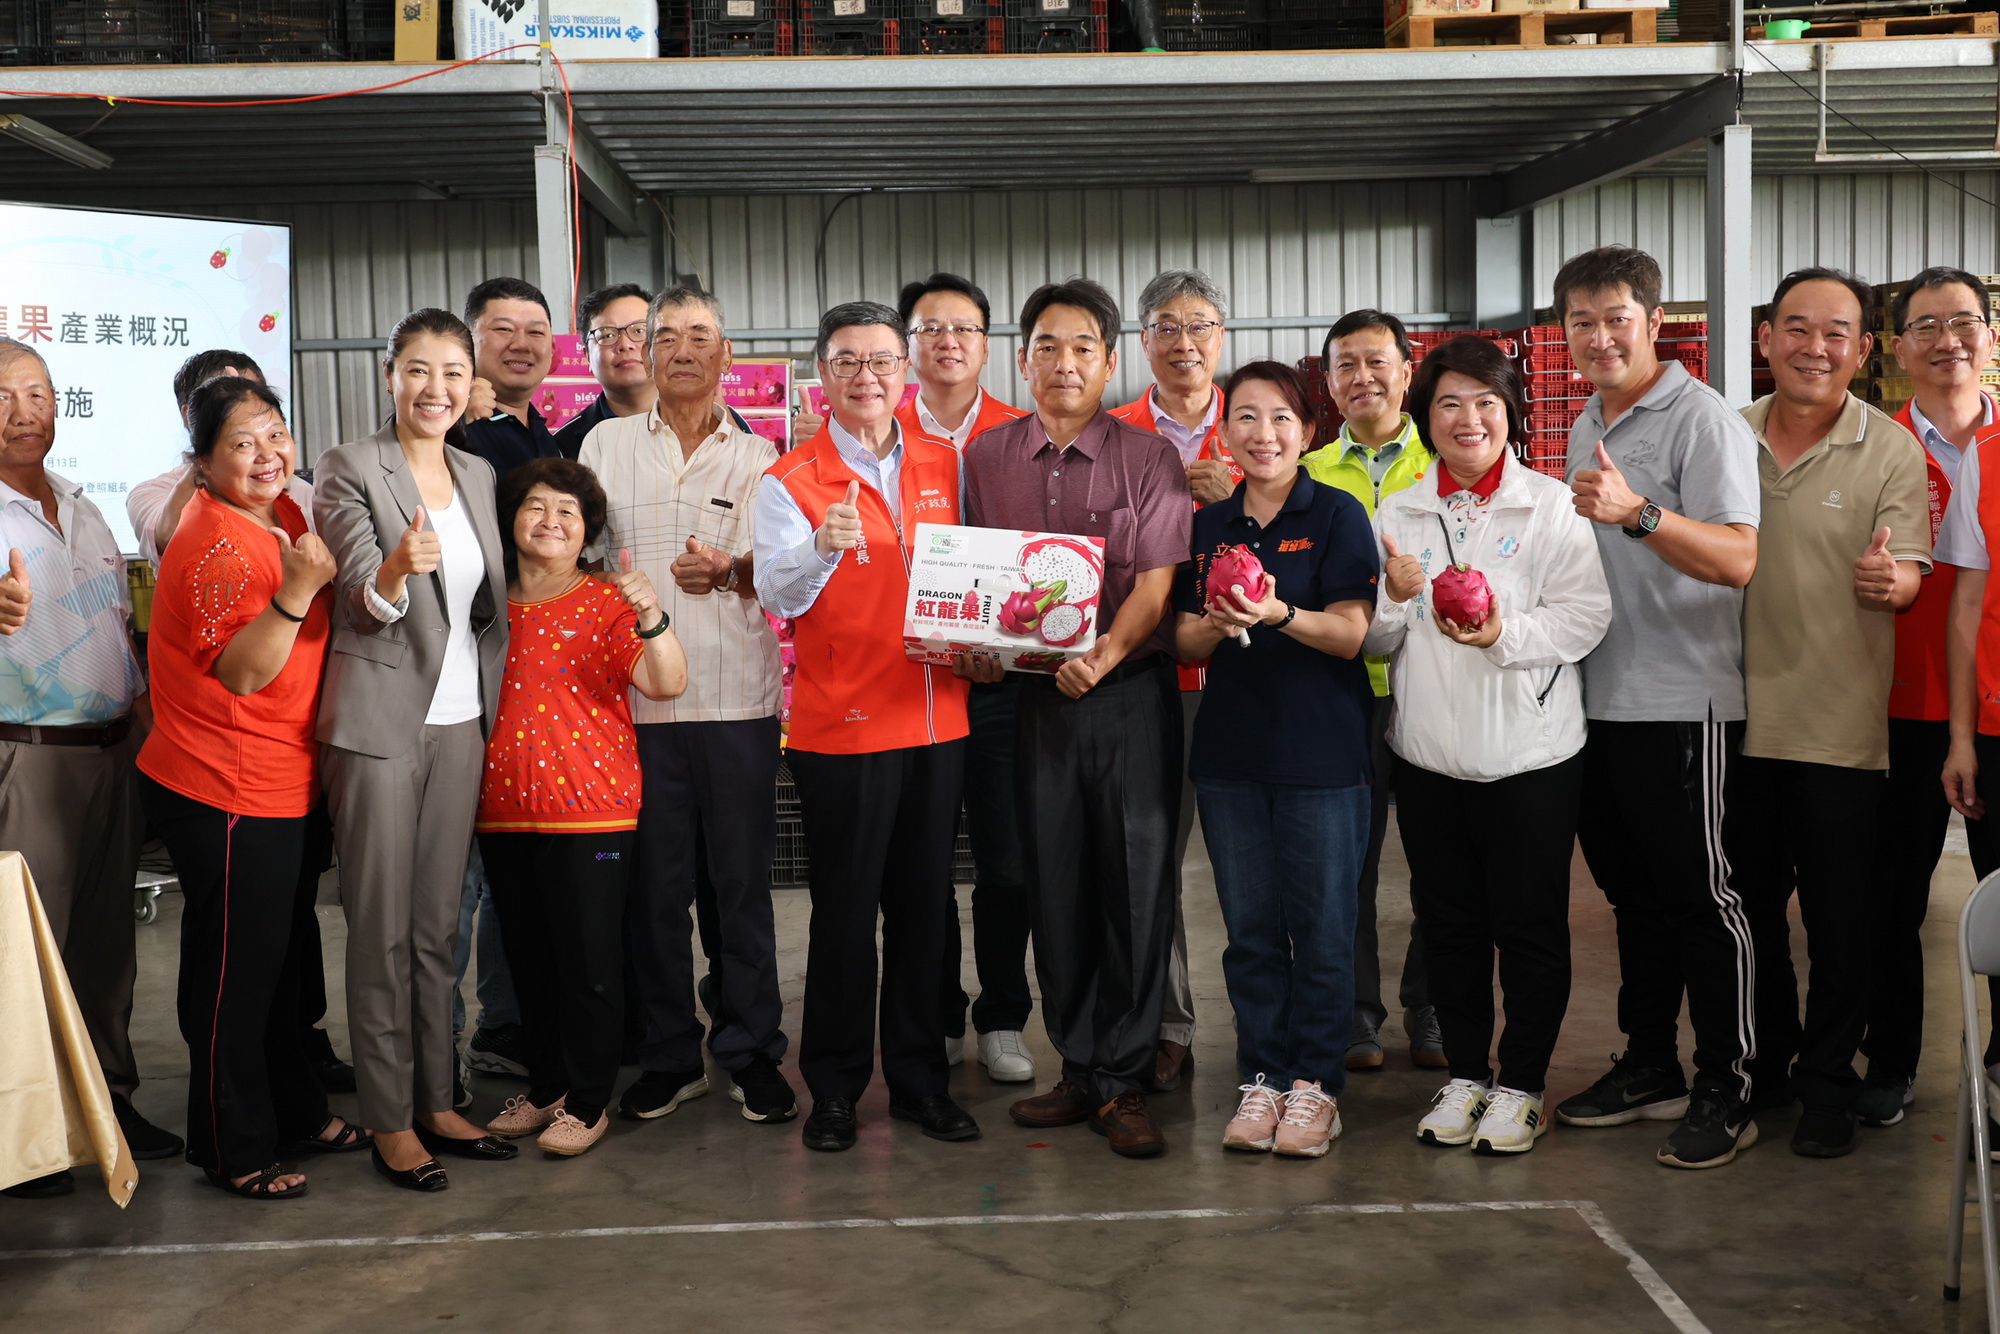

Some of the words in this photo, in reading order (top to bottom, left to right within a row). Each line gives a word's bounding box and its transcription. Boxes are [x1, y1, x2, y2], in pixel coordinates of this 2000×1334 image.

[532, 14, 571, 24] SUBSTTE
[572, 15, 621, 25] PROFESSIONAL
[524, 24, 622, 39] MiKSKAR
[720, 372, 742, 382] less
[561, 408, 585, 417] 紫水
[46, 457, 77, 468] 月13日
[913, 496, 951, 514] 行政院
[939, 560, 968, 568] QUALITY
[972, 563, 995, 571] FRESH
[1000, 565, 1026, 573] TAIWAN
[1412, 547, 1433, 622] 南投議員
[917, 589, 963, 600] DRAGON
[914, 598, 981, 621] 紅龍果
[981, 595, 992, 625] FRUIT
